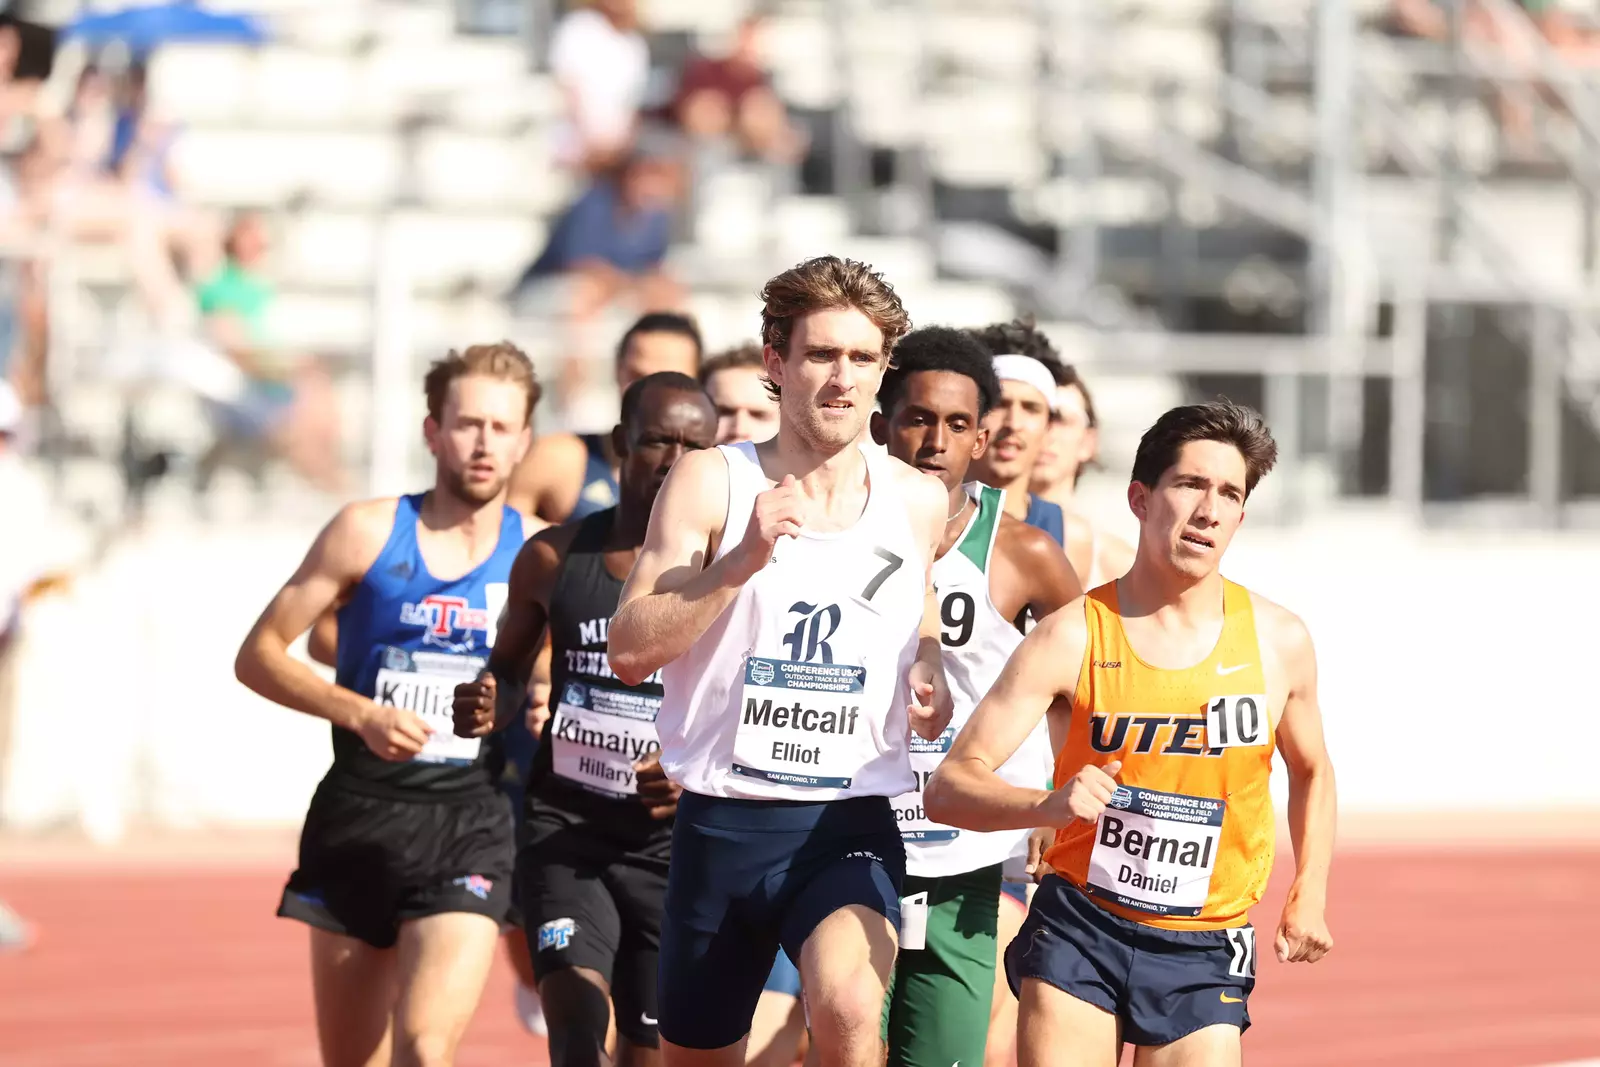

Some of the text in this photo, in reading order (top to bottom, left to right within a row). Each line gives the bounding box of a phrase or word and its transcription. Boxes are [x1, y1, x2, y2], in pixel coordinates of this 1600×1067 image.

[860, 545, 904, 602] 7
[579, 618, 612, 645] MI
[940, 592, 975, 647] 9
[780, 663, 840, 676] CONFERENCE
[784, 673, 813, 681] OUTDOOR
[787, 680, 850, 692] CHAMPIONSHIPS
[743, 698, 860, 735] Metcalf
[1211, 697, 1259, 745] 10
[557, 717, 660, 761] Kimaiyo
[771, 741, 821, 765] Elliot
[579, 756, 633, 787] Hillary
[780, 774, 809, 784] ANTONIO,
[1138, 791, 1199, 808] CONFERENCE
[1200, 800, 1219, 810] USA
[1141, 800, 1170, 811] OUTDOOR
[1171, 806, 1190, 814] TRACK
[1195, 809, 1212, 817] FIELD
[1143, 808, 1208, 824] CHAMPIONSHIPS
[1100, 815, 1213, 868] Bernal
[1117, 864, 1178, 894] Daniel
[1118, 896, 1131, 905] SAN
[1130, 899, 1158, 911] ANTONIO,
